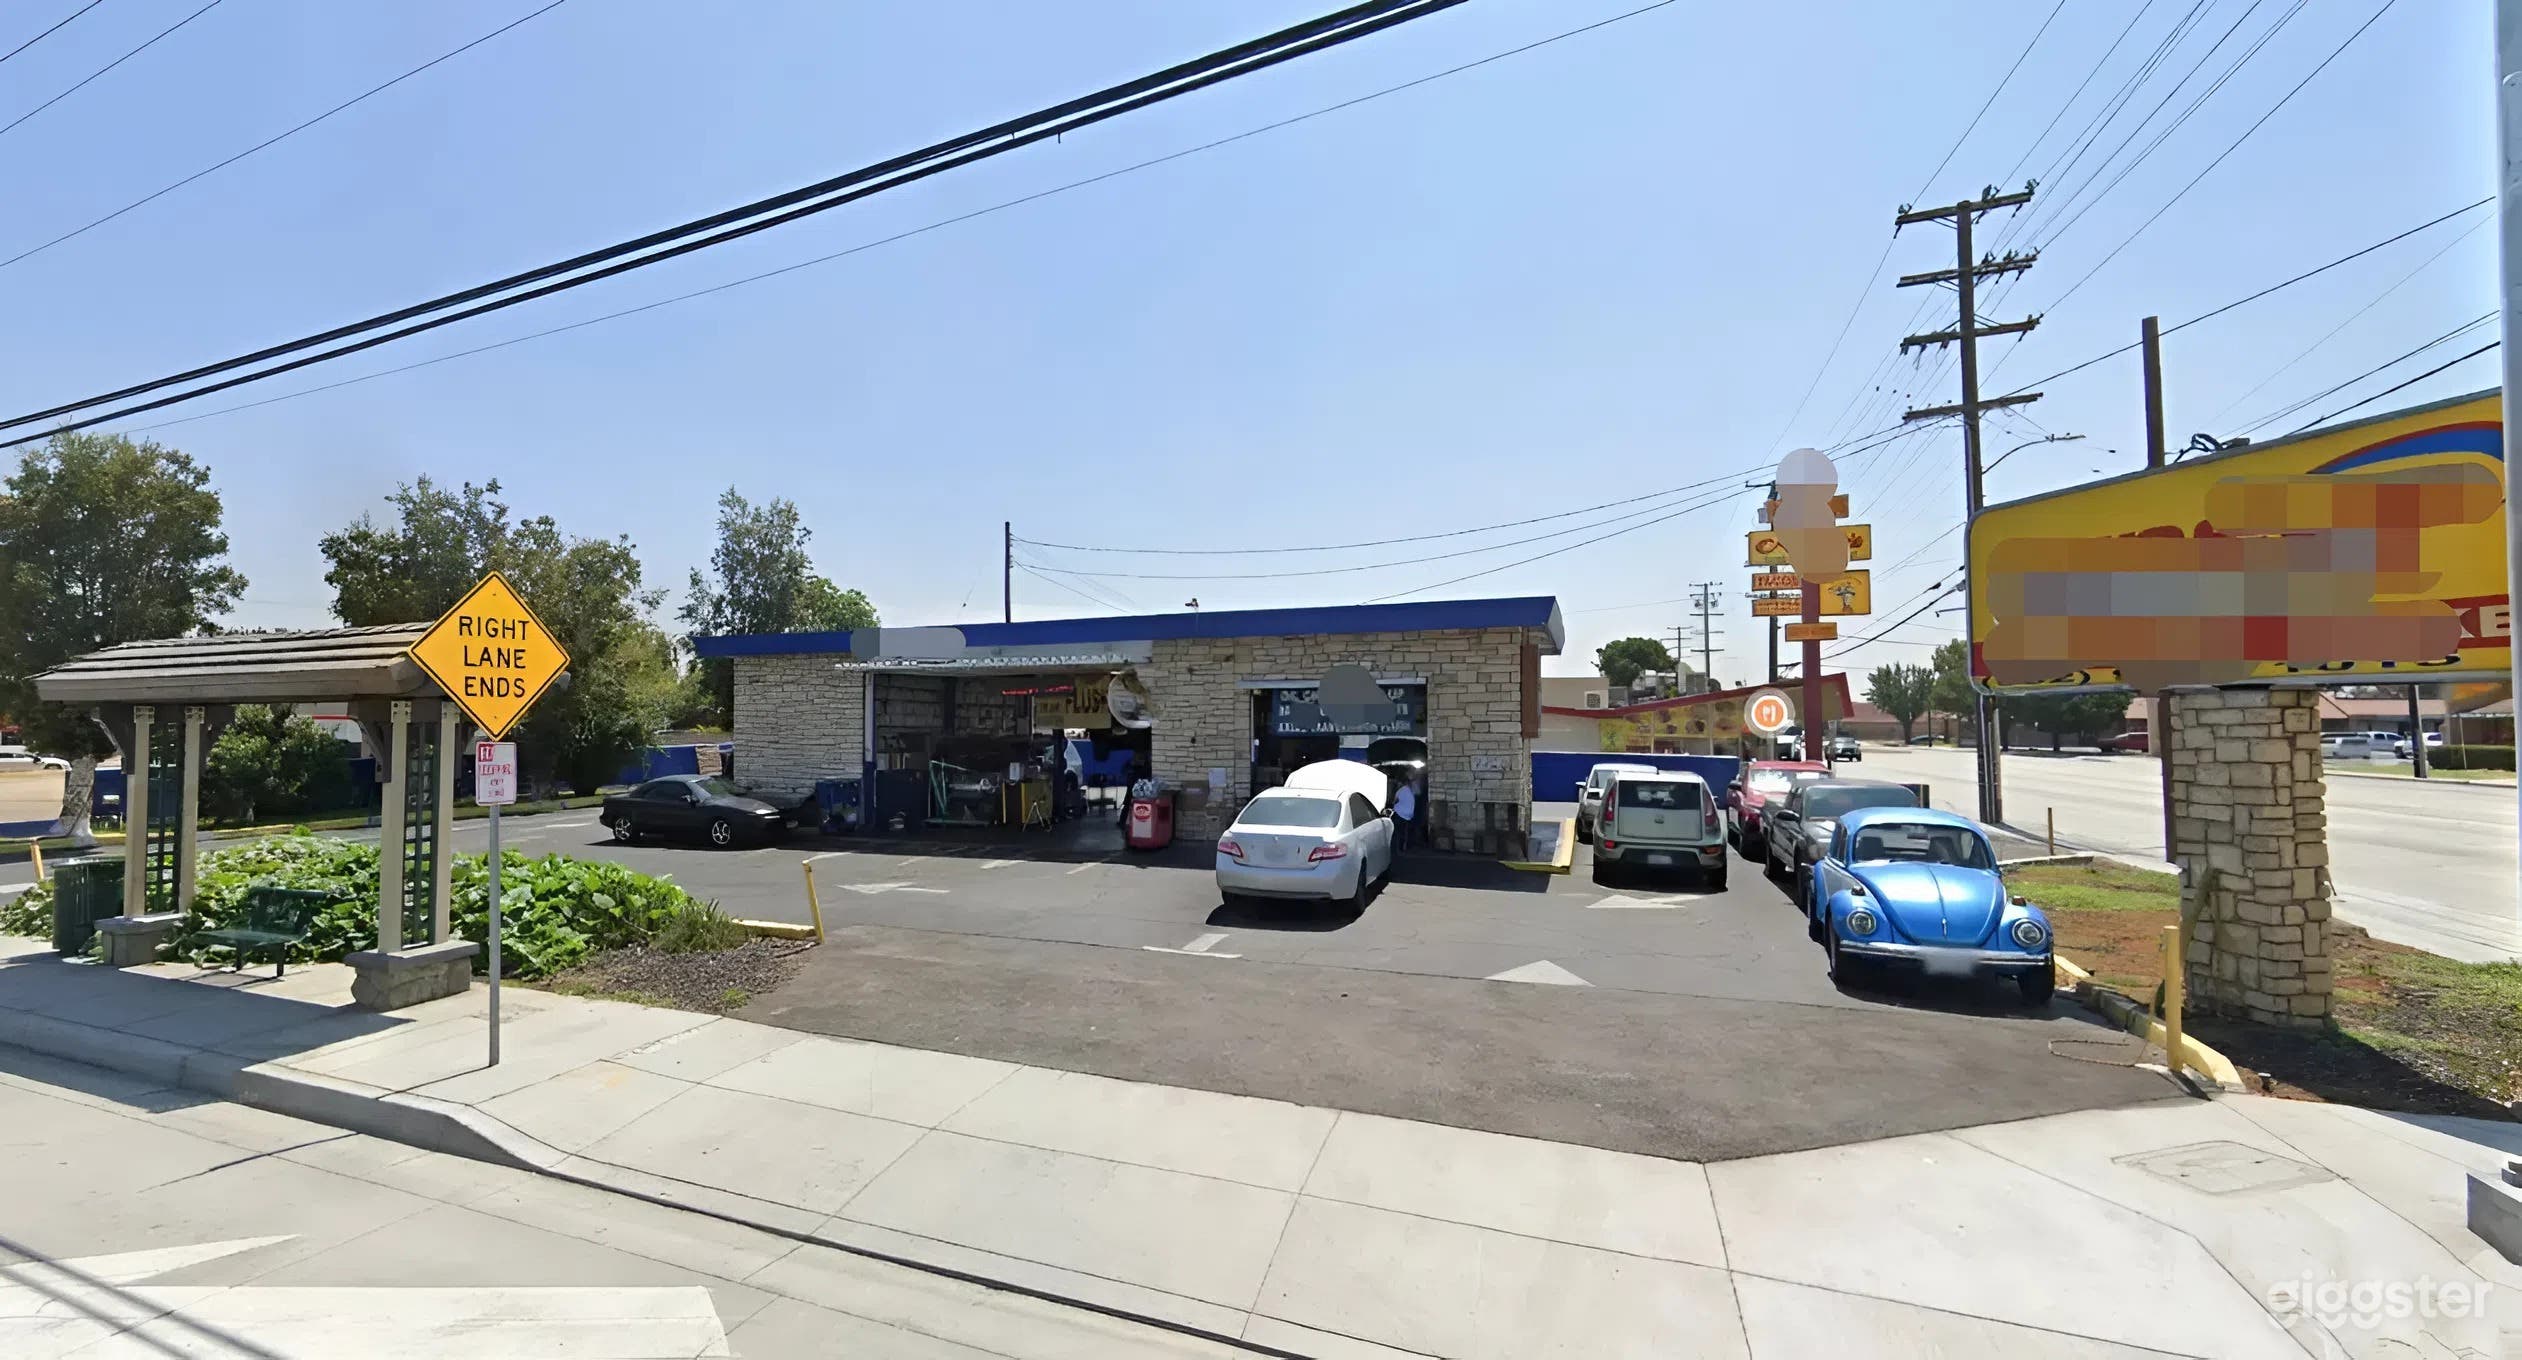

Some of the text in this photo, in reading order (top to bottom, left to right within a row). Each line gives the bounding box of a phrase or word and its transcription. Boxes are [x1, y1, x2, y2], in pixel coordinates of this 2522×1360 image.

[458, 615, 529, 640] RIGHT
[464, 645, 526, 669] LANE
[464, 676, 526, 698] ENDS
